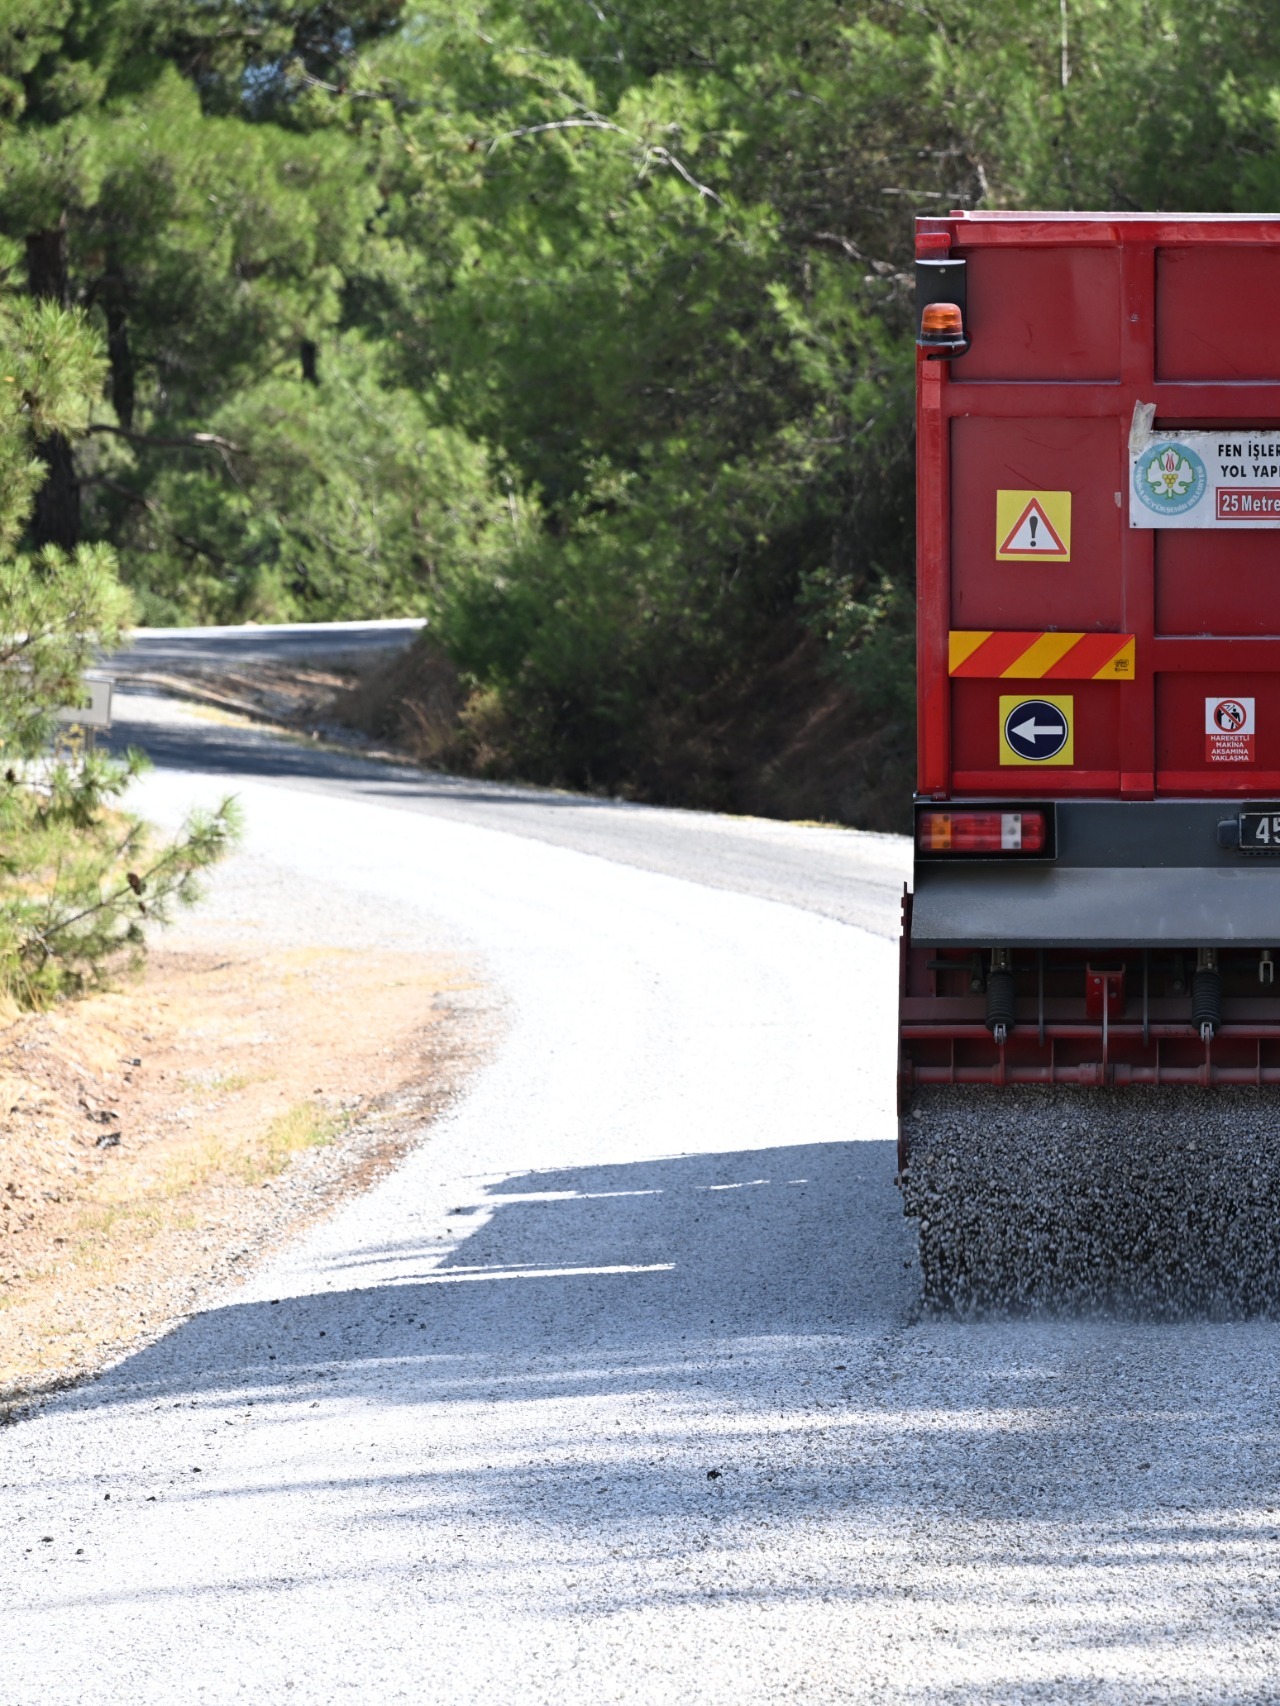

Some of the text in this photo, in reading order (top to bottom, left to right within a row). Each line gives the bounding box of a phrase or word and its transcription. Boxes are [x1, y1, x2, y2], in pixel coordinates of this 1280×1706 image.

[1218, 444, 1242, 457] FEN
[1221, 465, 1247, 478] YOL
[1222, 495, 1239, 512] 25
